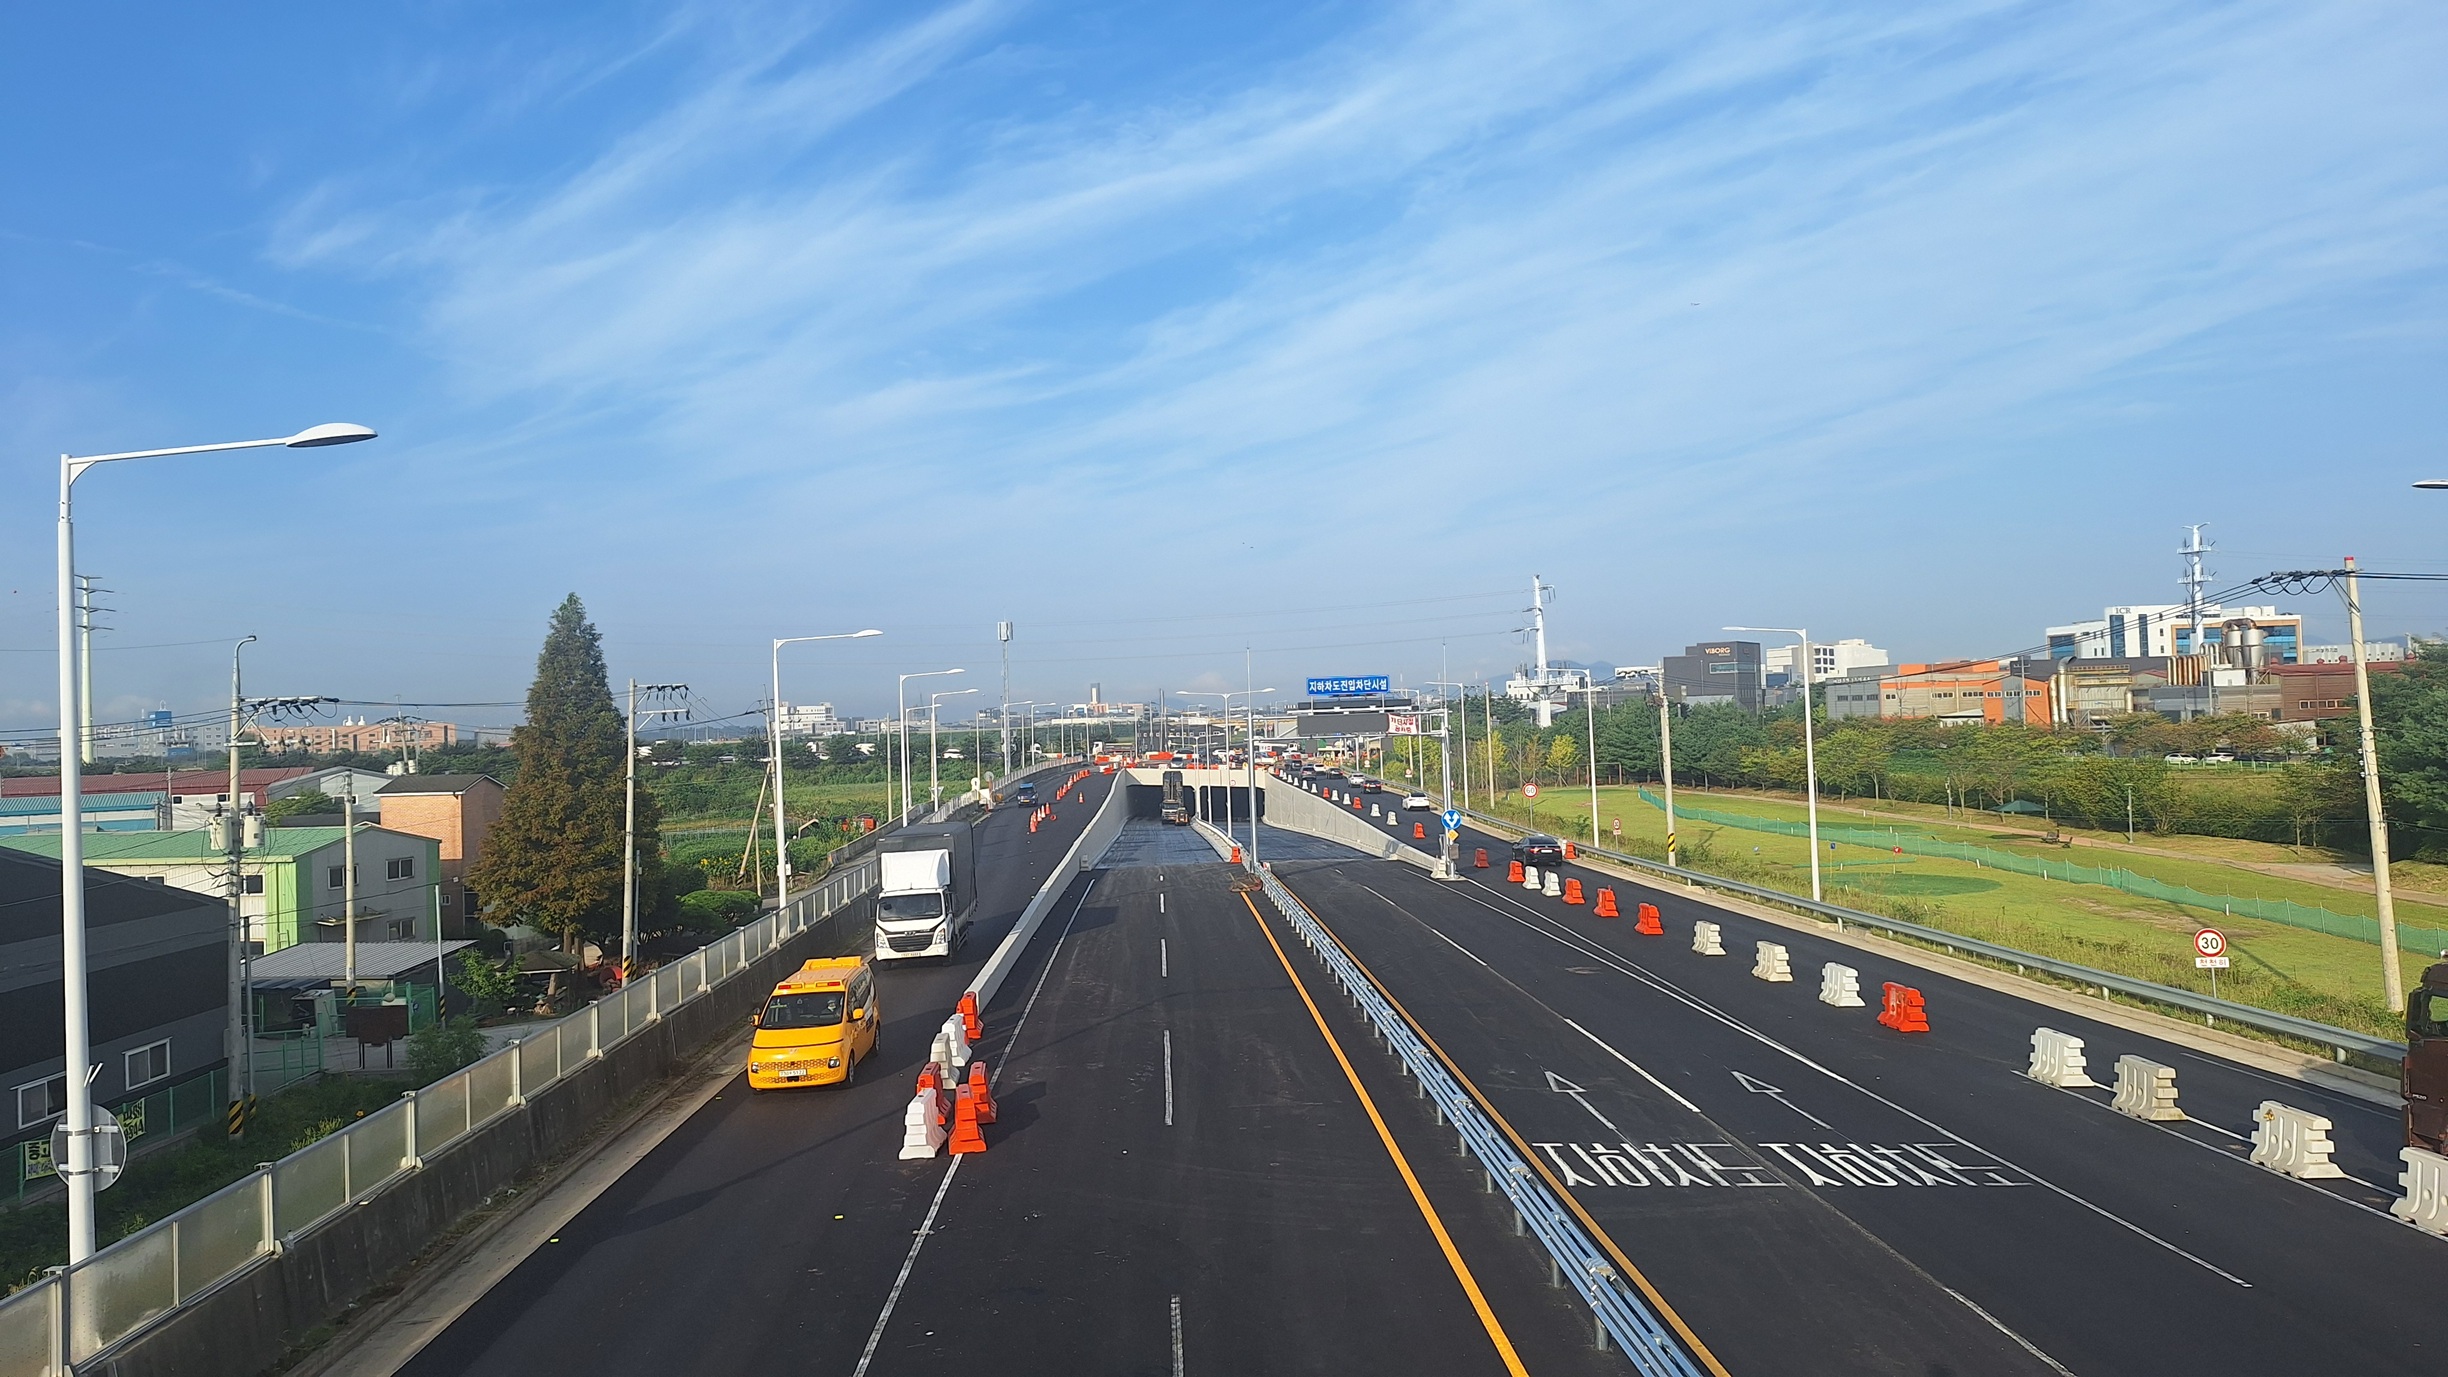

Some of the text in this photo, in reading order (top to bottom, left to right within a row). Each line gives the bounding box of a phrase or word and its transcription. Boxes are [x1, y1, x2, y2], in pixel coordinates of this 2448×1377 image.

[2115, 607, 2132, 615] ICR
[1704, 646, 1731, 655] VIBORG
[1309, 678, 1387, 692] 지하차도진입차단시설
[1525, 786, 1535, 794] 60
[2201, 936, 2219, 950] 30
[2200, 958, 2227, 967] 천천히
[1532, 1142, 1789, 1187] 지하차도
[1757, 1142, 2035, 1187] 지하차도
